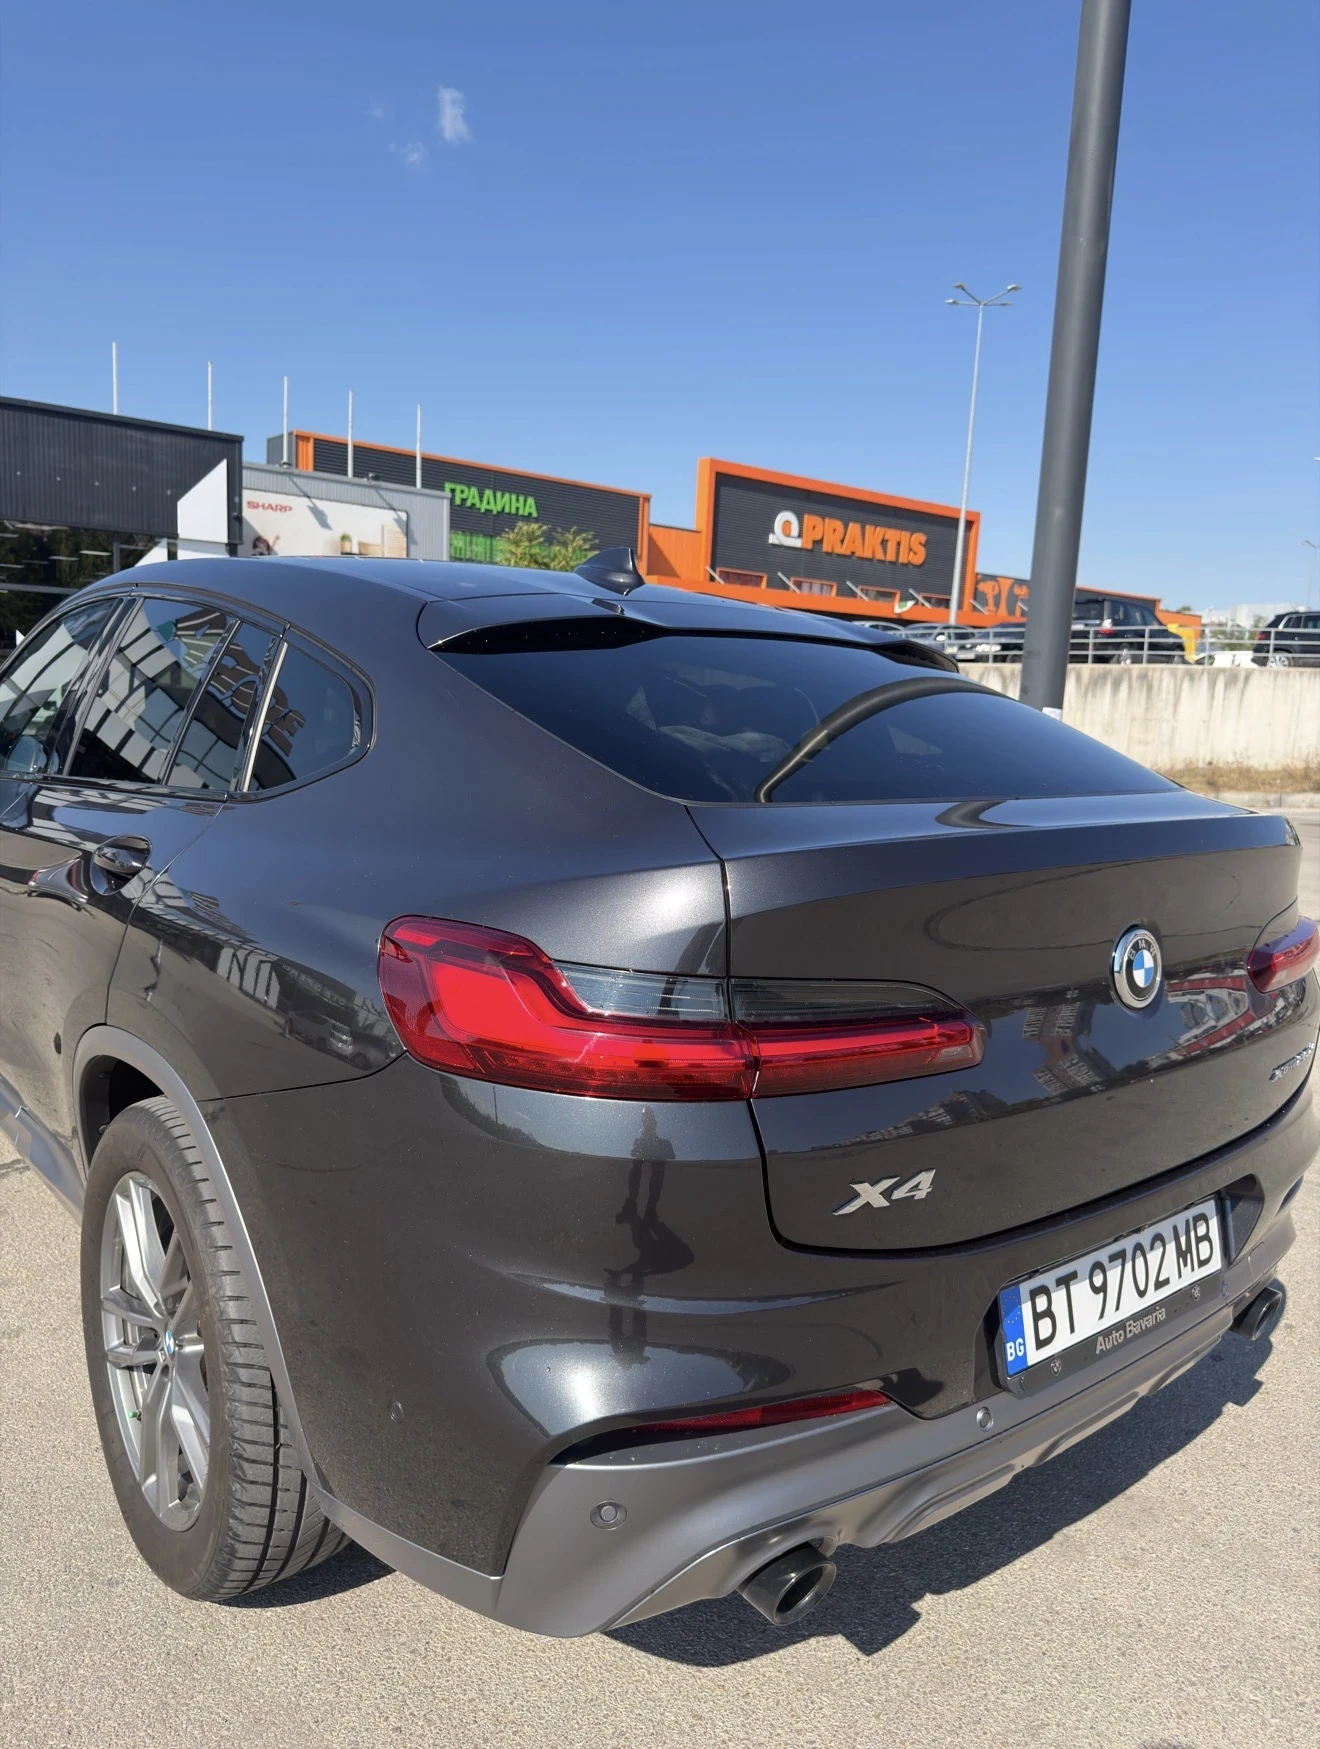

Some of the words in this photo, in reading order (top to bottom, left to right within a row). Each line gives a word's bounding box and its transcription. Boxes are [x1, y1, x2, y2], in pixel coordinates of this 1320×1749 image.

[246, 500, 293, 513] SHARP
[444, 481, 538, 518] ГРАДИНА
[802, 513, 927, 566] PRAKTIS
[1127, 938, 1158, 961] BMW
[831, 1167, 937, 1216] X4
[1029, 1270, 1079, 1351] BT
[1088, 1232, 1170, 1322] 9702
[1172, 1211, 1214, 1280] MB
[1006, 1337, 1025, 1361] BG
[1095, 1330, 1125, 1355] Auto
[1125, 1305, 1167, 1339] Bavaria
